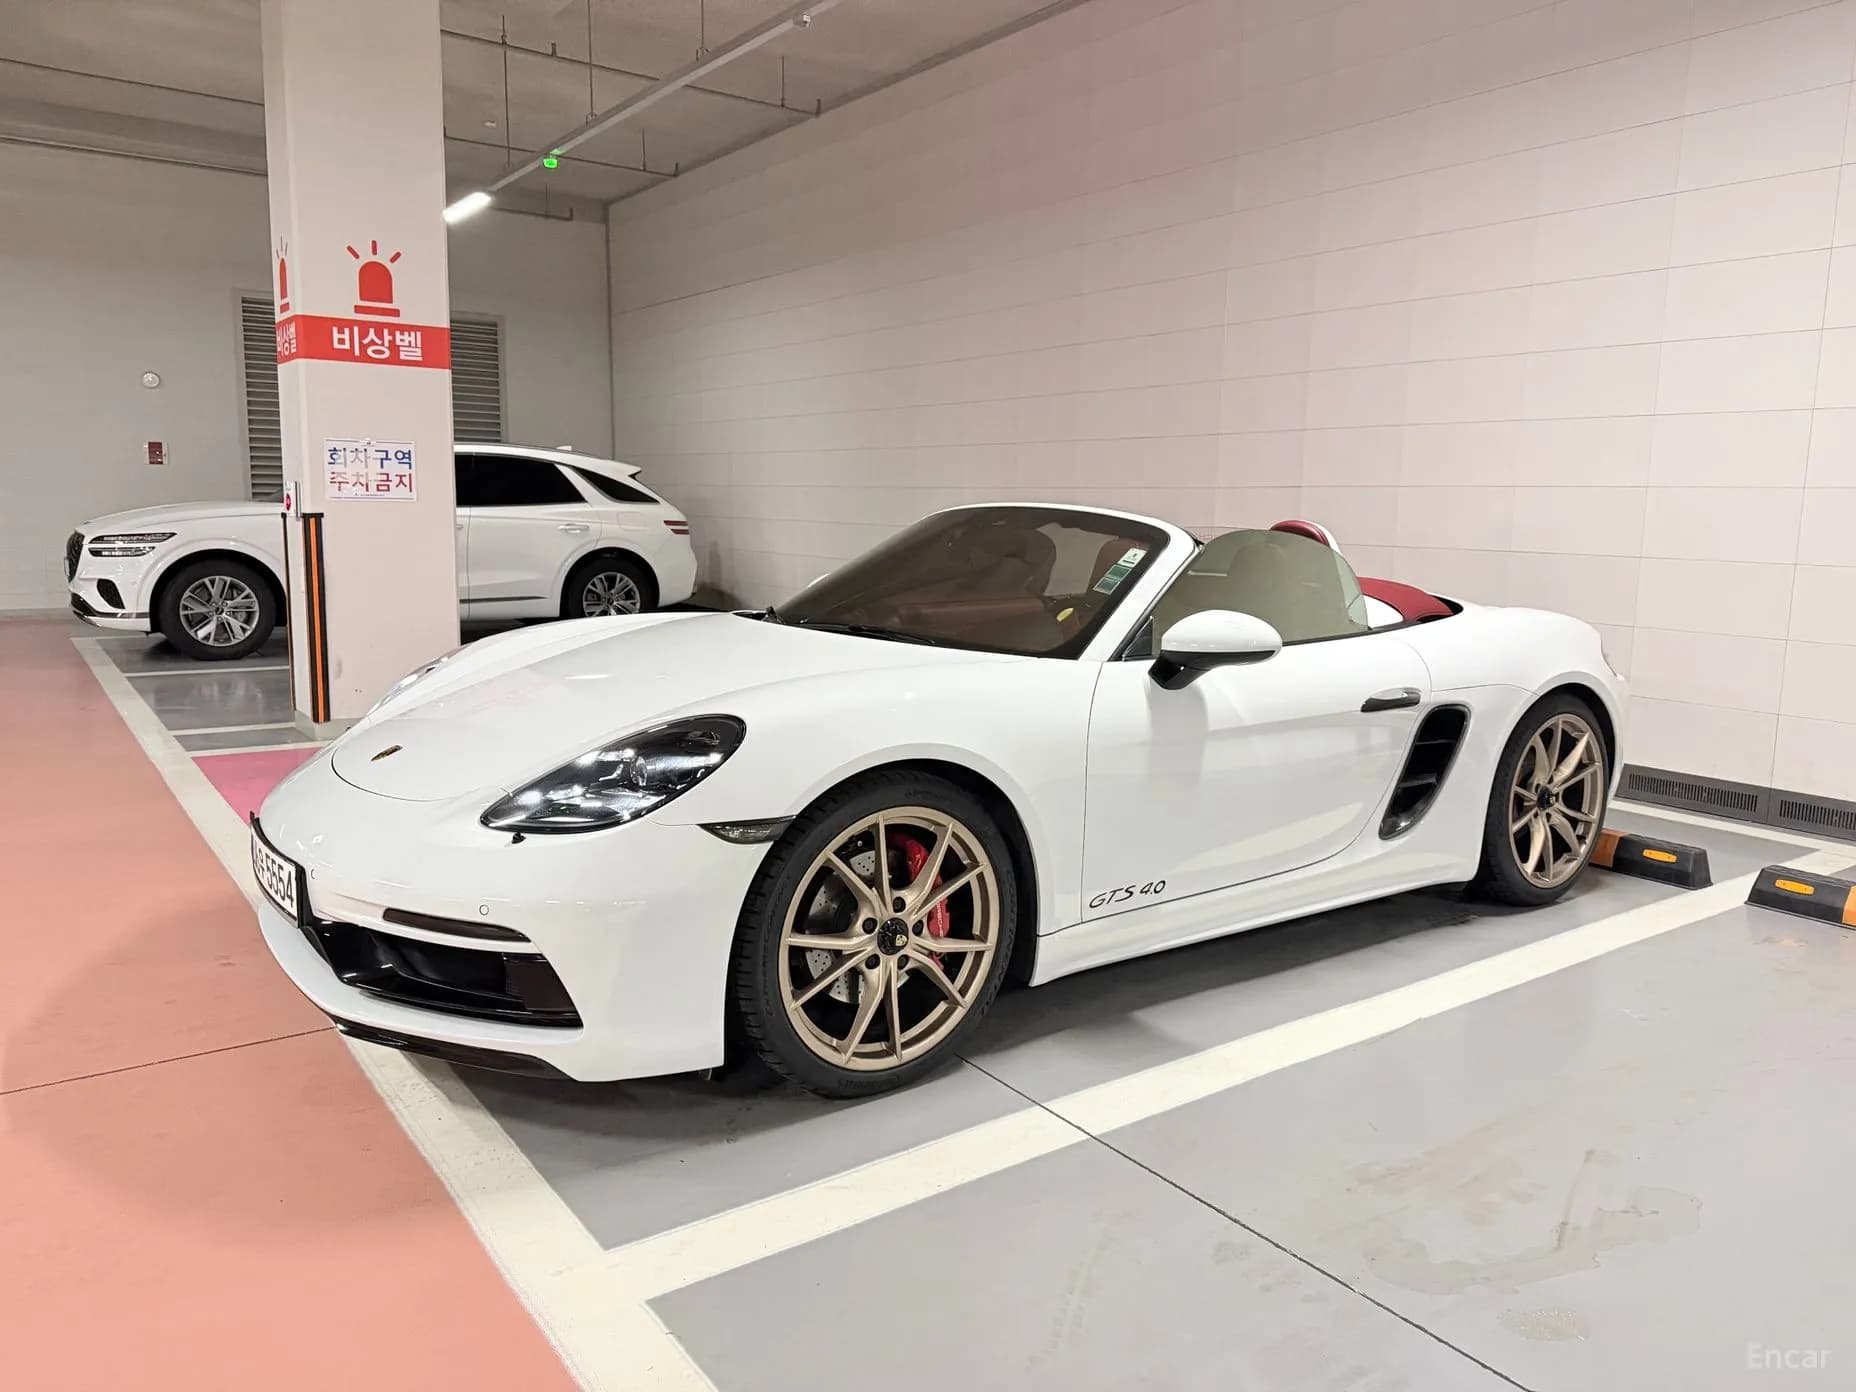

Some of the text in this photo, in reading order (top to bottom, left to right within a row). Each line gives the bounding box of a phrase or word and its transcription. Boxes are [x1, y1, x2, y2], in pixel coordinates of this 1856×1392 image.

[332, 325, 424, 361] 비상벨
[329, 471, 413, 493] 주차금지
[1089, 880, 1166, 908] GTS 4.0
